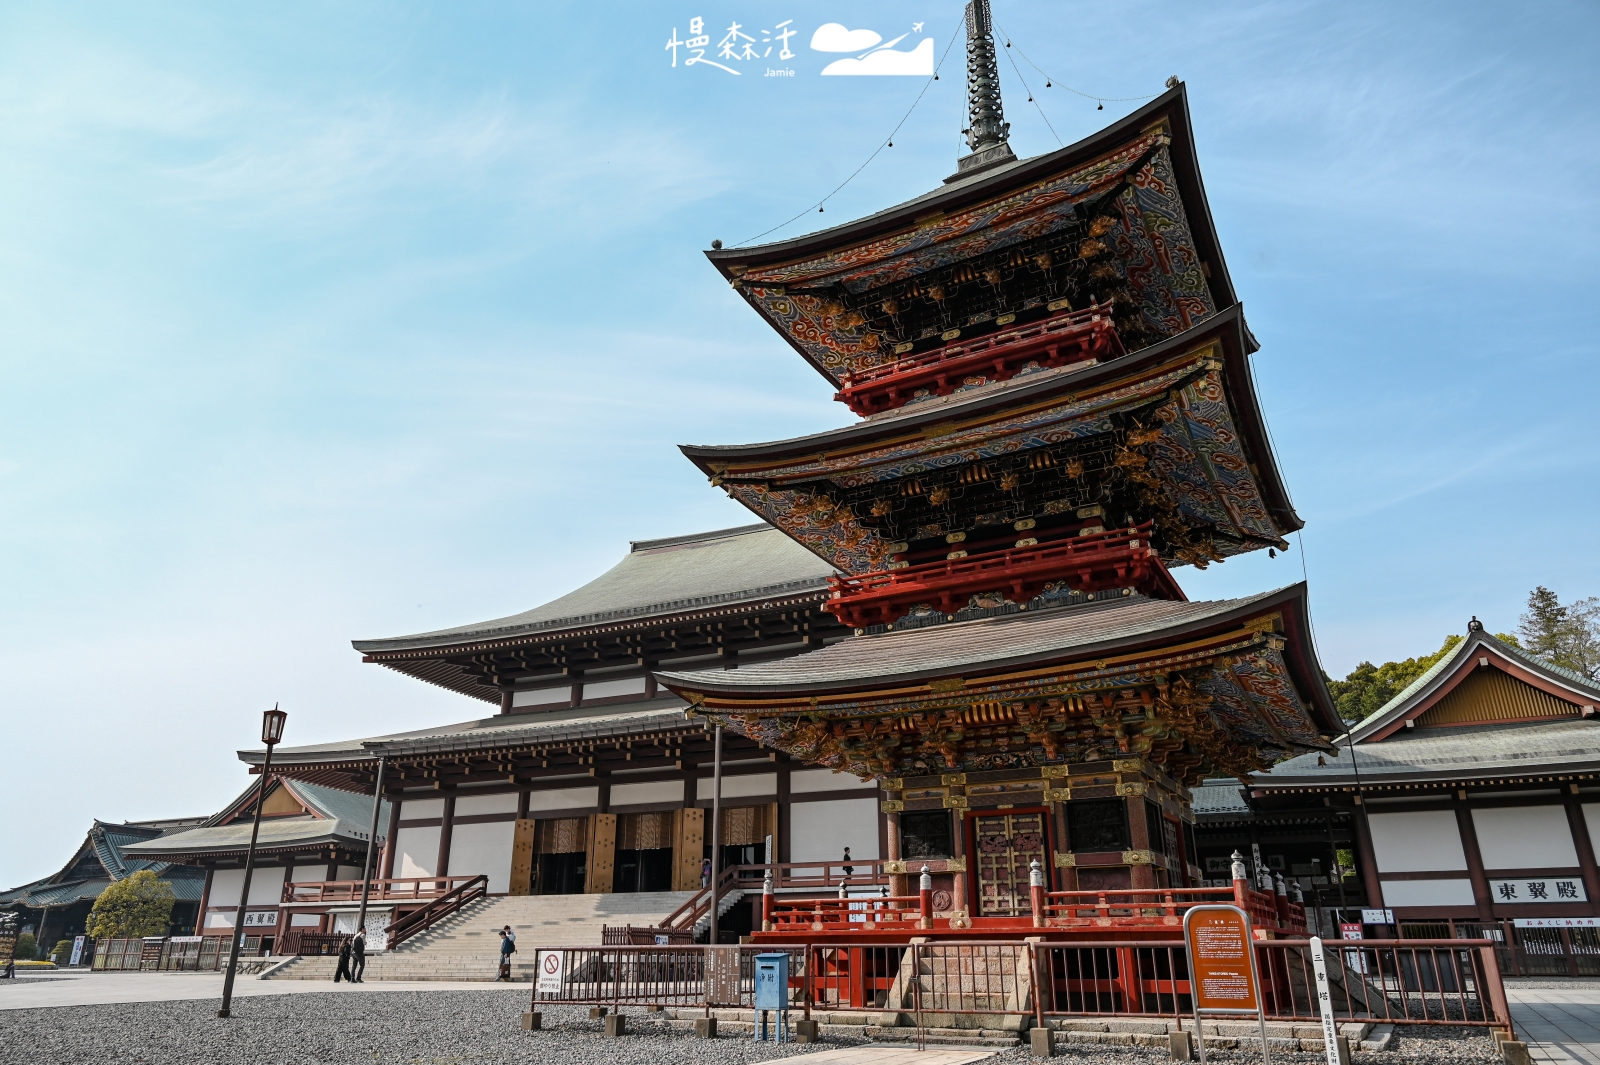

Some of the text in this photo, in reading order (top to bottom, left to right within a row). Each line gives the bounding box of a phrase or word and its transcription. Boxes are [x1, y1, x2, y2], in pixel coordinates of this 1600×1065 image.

[1498, 881, 1579, 899] 東翼殿
[245, 913, 275, 924] 西翼殿
[1314, 954, 1328, 1000] 三重塔
